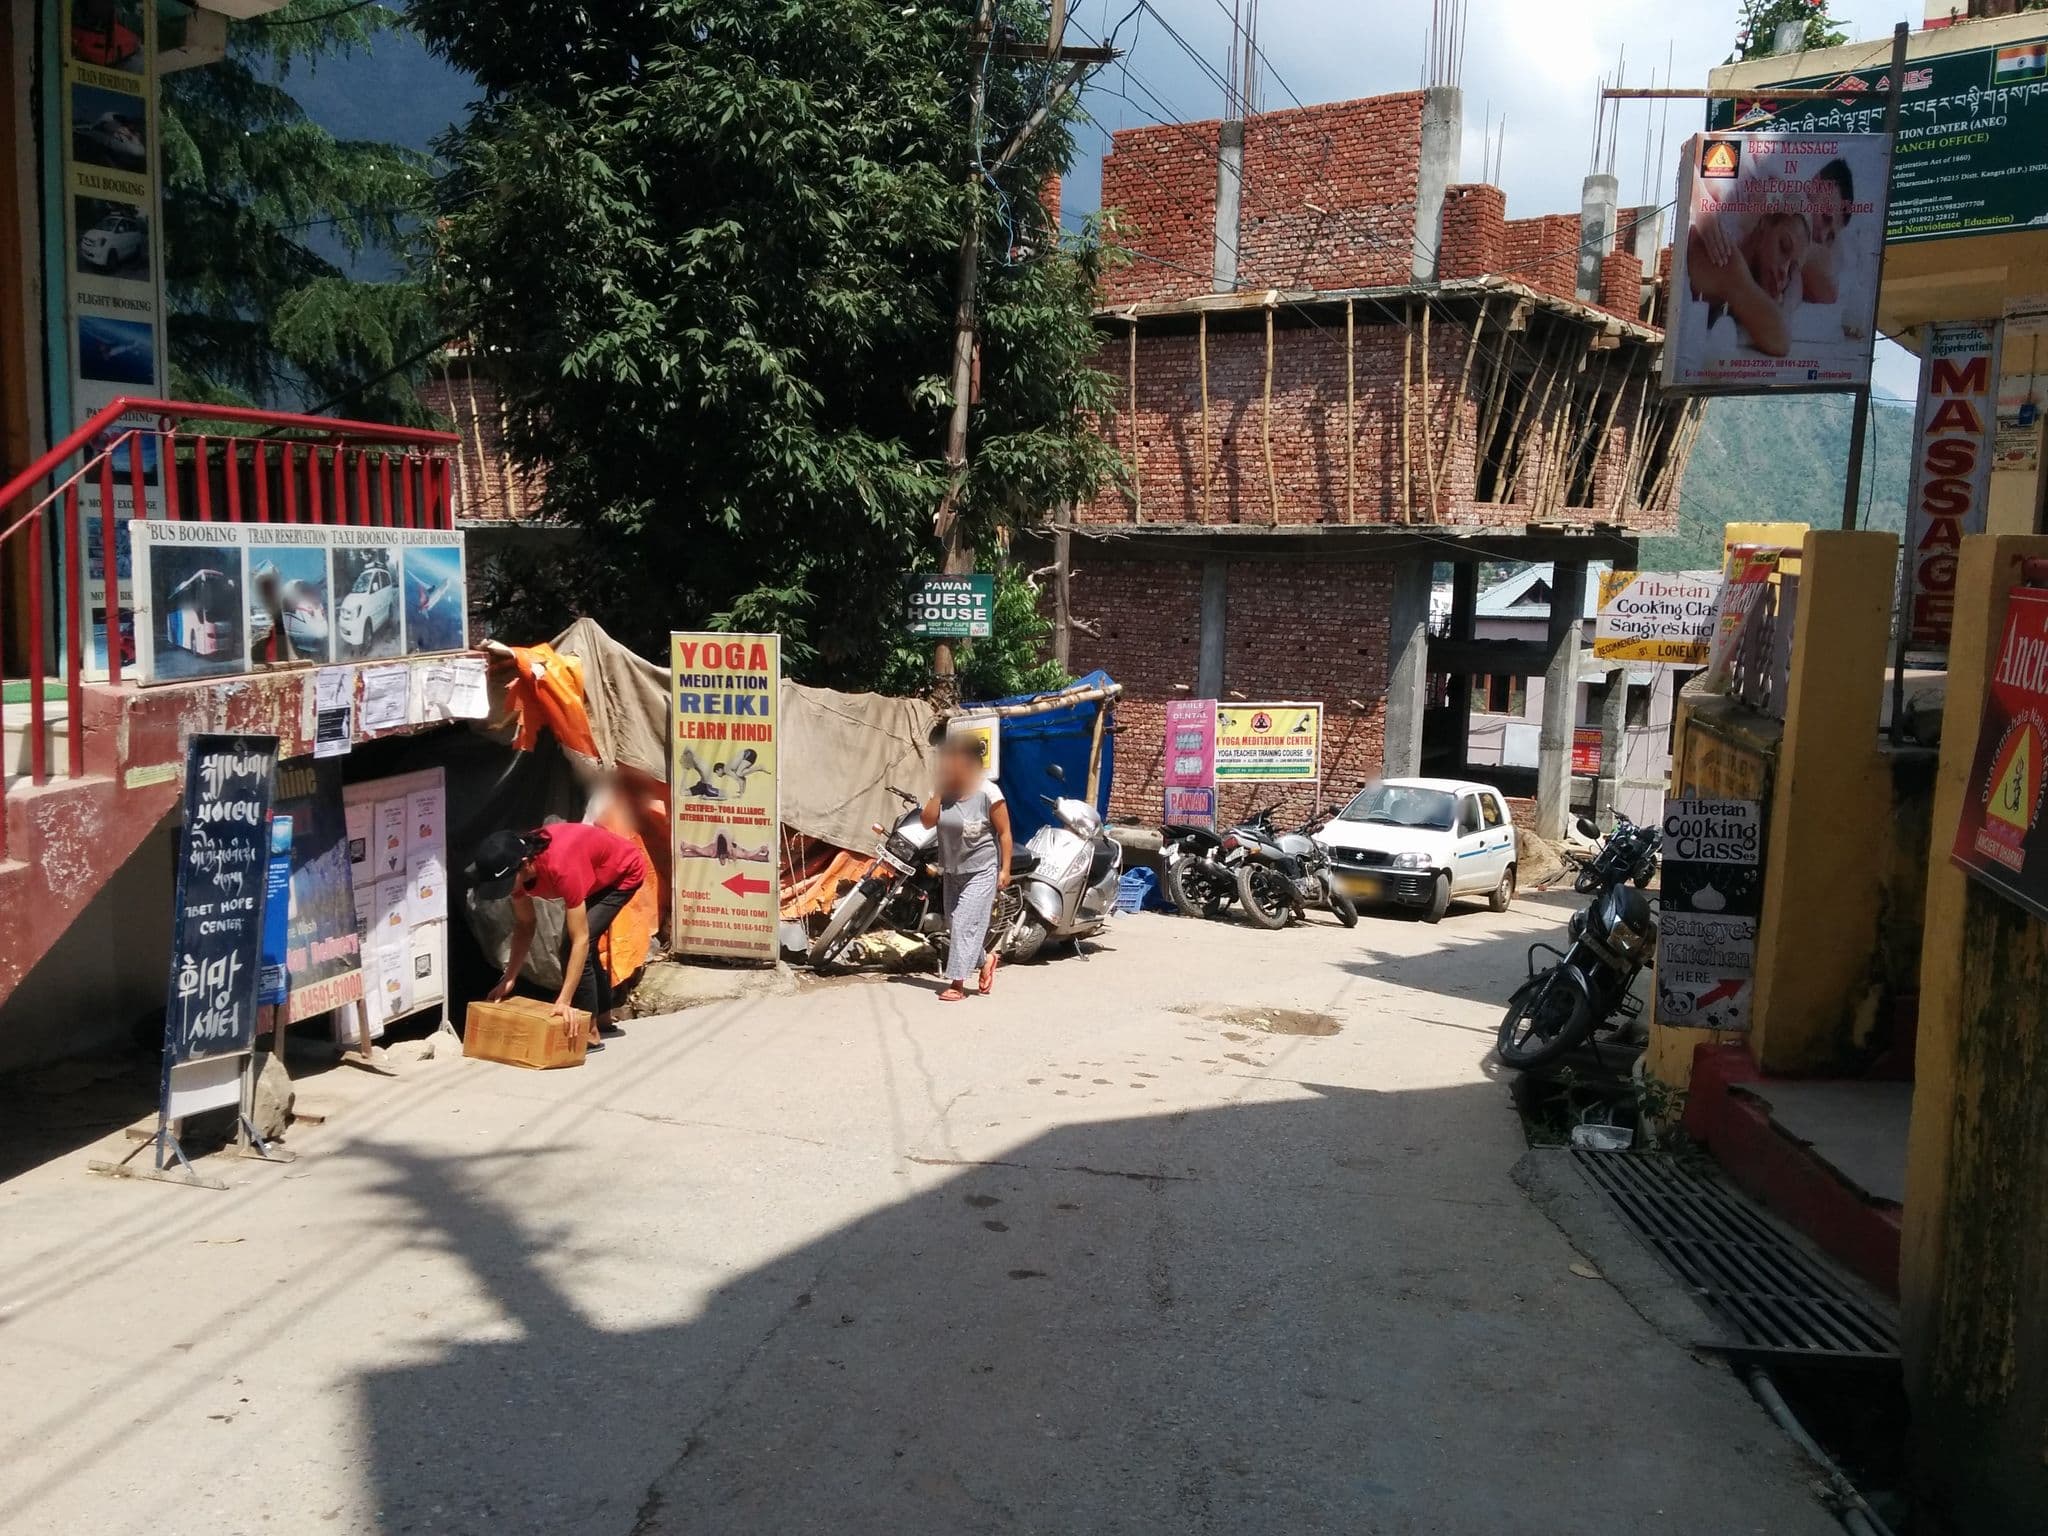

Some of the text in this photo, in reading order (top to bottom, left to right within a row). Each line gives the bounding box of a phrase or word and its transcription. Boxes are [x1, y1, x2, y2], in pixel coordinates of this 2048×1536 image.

[1926, 119, 1968, 136] CENTER
[1970, 115, 2008, 131] (ANEC)
[1748, 140, 1777, 154] BEST
[1780, 140, 1839, 156] MASSAGE
[1938, 131, 1990, 149] OFFICE)
[1784, 159, 1797, 174] IN
[78, 172, 145, 197] TAXI BOOKING
[1700, 199, 1779, 213] Recommended
[1905, 221, 1962, 233] Nonviolence
[1964, 213, 2014, 227] Education)
[78, 292, 152, 312] FLIGHT BOOKING
[1911, 356, 1992, 644] MASSAGE
[150, 524, 460, 545] BUS BOOKING TRAIN RESERVATION TAXI BOOKING FLIGHT BOOKING
[924, 582, 972, 591] PAWAN
[1636, 581, 1710, 598] Tibetan
[908, 593, 987, 606] GUEST
[907, 607, 987, 621] HOUSE
[1617, 599, 1683, 621] Cooking
[1598, 636, 1641, 656] RECOMMENDED
[1639, 647, 1649, 656] BY
[1658, 644, 1700, 657] LONELY
[679, 642, 768, 671] YOGA
[679, 673, 768, 690] MEDITATION
[679, 692, 769, 717] REIKI
[679, 720, 772, 743] LEARN HINDI
[1222, 736, 1312, 746] YOGA MEDITATION CENTRE
[1170, 792, 1208, 811] PAWAN
[1679, 801, 1746, 817] Tibetan
[680, 813, 725, 824] INTERNATIONAL
[719, 805, 735, 814] YOGA
[737, 806, 765, 816] ALLIANCE
[1167, 814, 1211, 827] GUEST HOUSE
[1664, 816, 1757, 851] Cooking
[682, 889, 711, 900] Contact:
[220, 897, 254, 913] HOPE
[696, 905, 729, 916] RASHPAL
[731, 908, 749, 917] YOGI
[200, 918, 243, 935] CENTER
[1661, 915, 1755, 946] Sangye's
[1666, 943, 1750, 969] Kitchen
[1675, 971, 1712, 984] HERE
